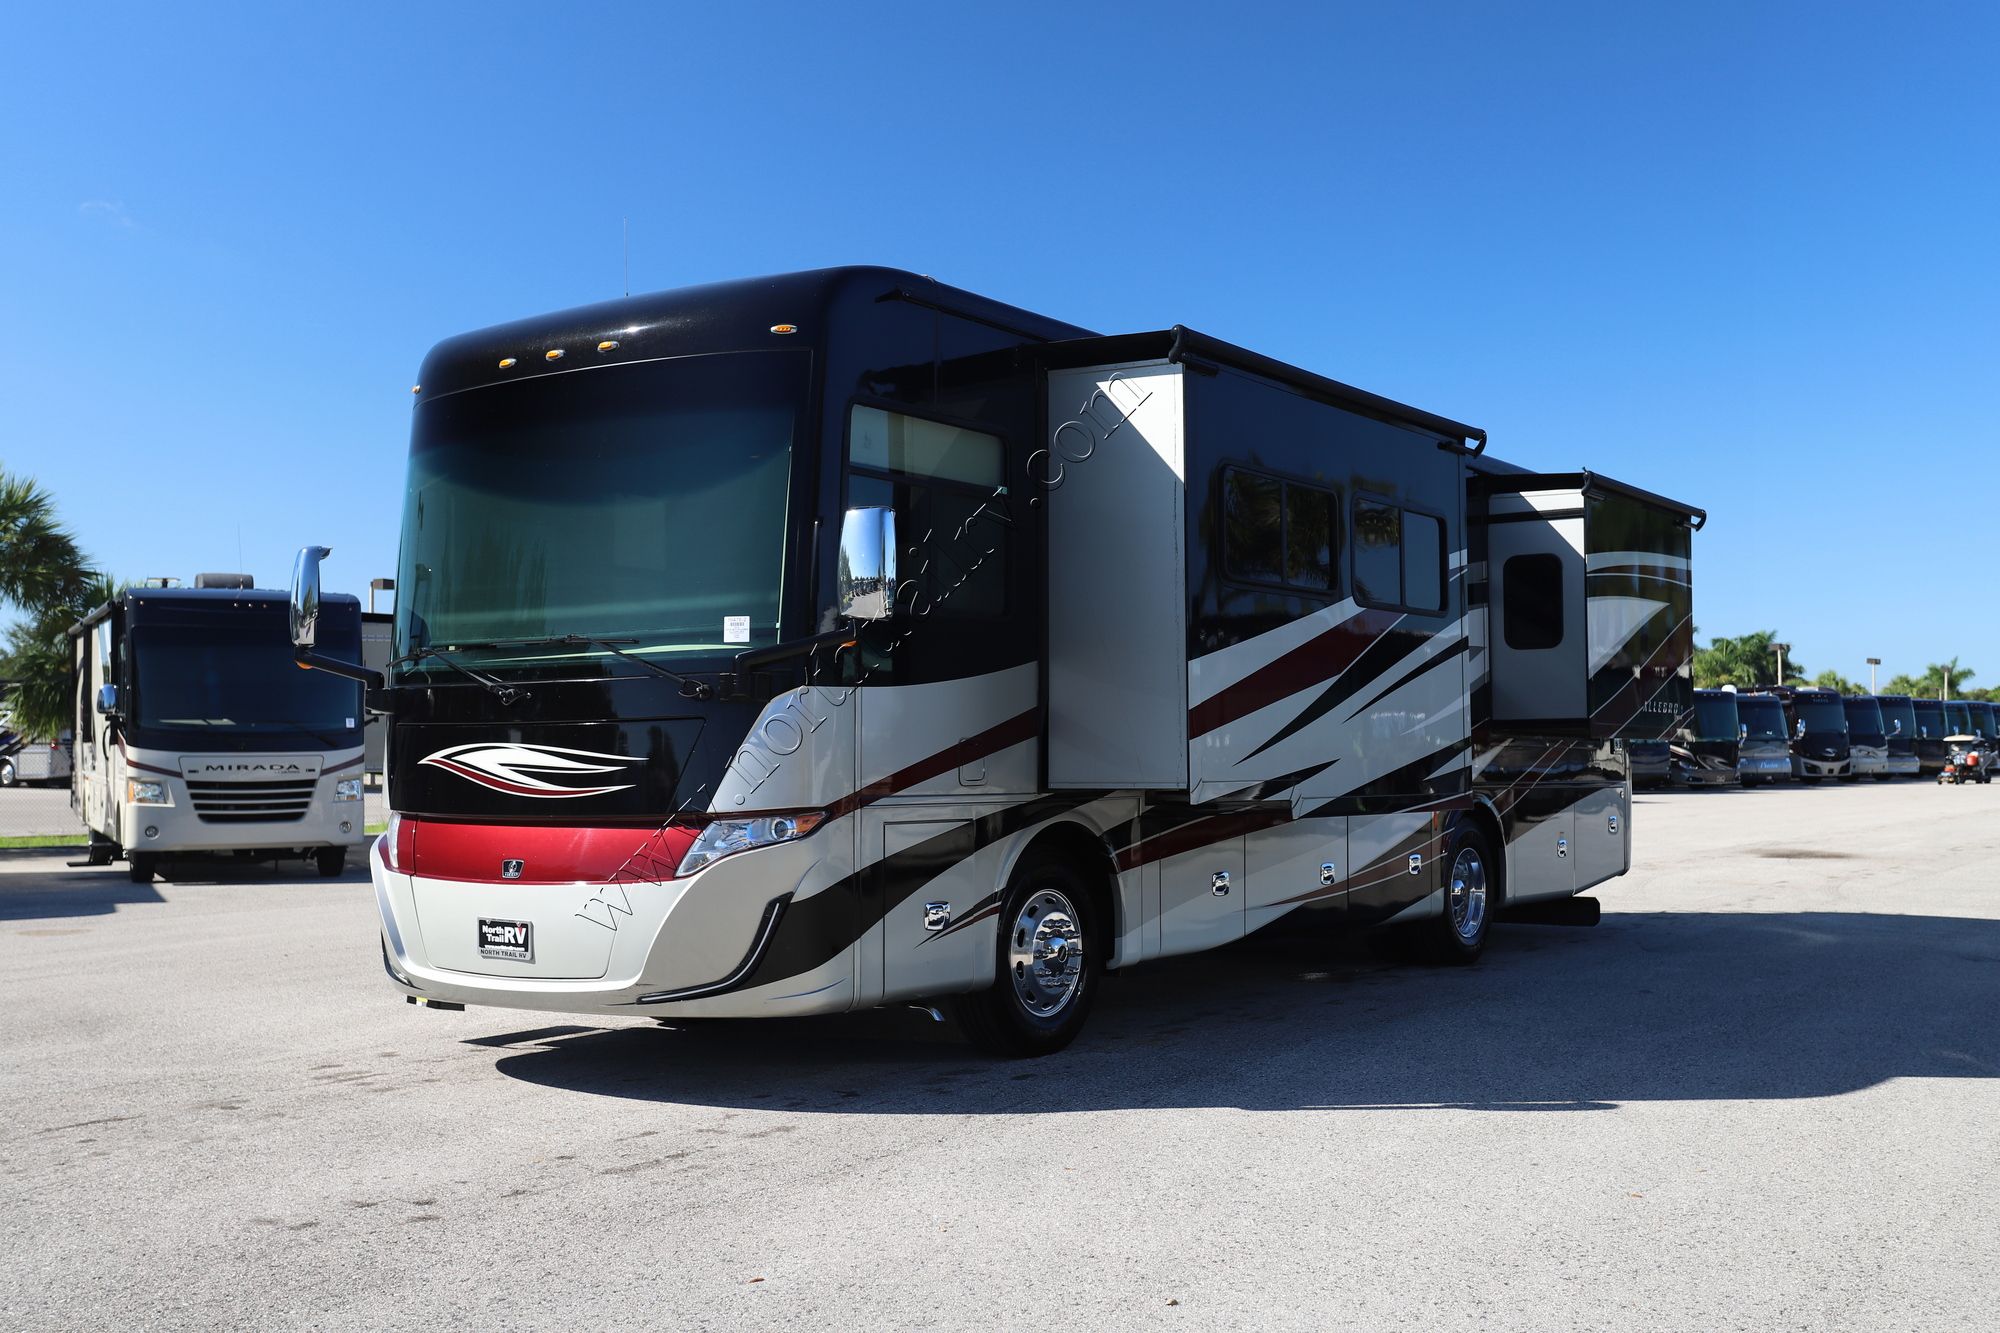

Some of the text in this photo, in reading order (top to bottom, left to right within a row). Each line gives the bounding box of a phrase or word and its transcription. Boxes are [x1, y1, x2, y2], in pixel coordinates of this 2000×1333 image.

[205, 764, 300, 772] MIRADA
[482, 925, 504, 934] North
[486, 934, 504, 943] Trail
[504, 926, 526, 944] RV
